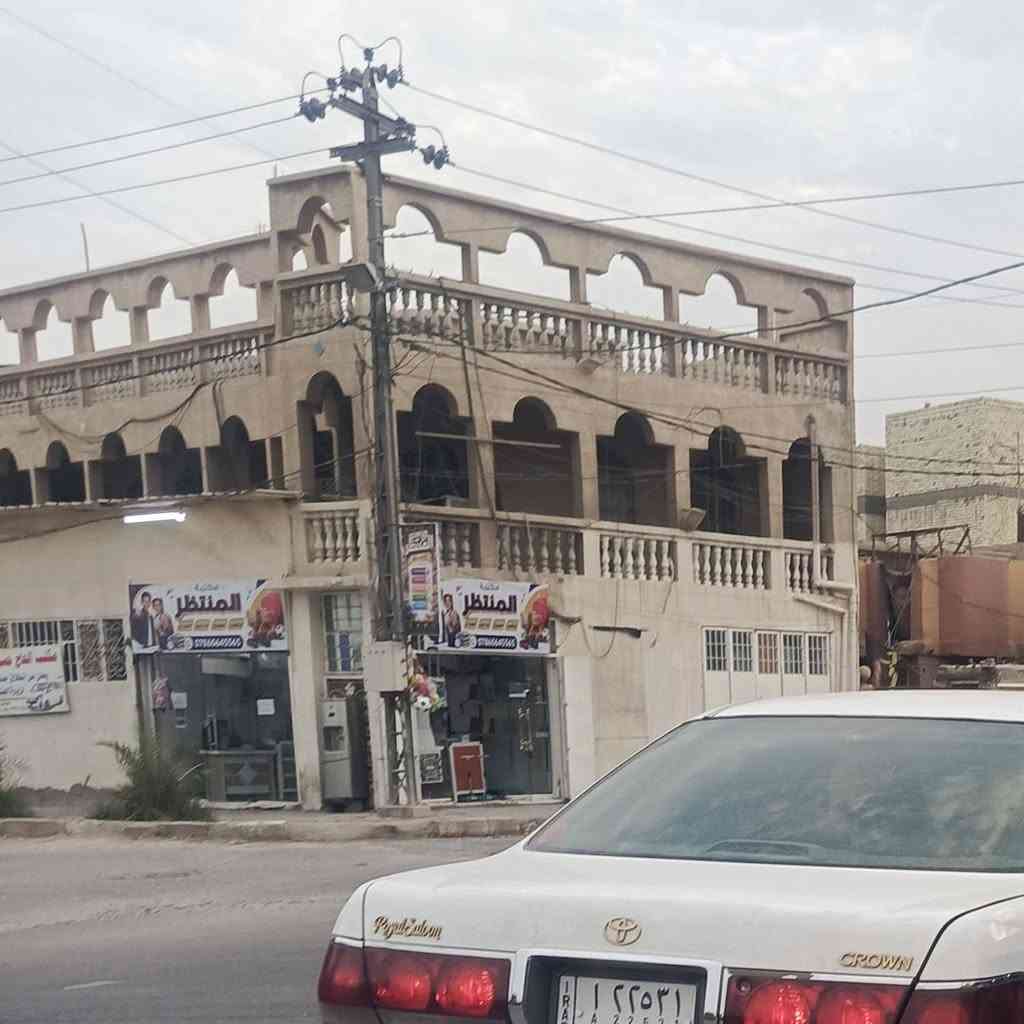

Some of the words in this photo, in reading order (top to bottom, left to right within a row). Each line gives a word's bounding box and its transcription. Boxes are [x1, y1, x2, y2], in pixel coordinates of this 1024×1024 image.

[175, 592, 242, 618] المنتظر
[462, 592, 517, 617] المنتظر
[840, 951, 914, 971] CROWN
